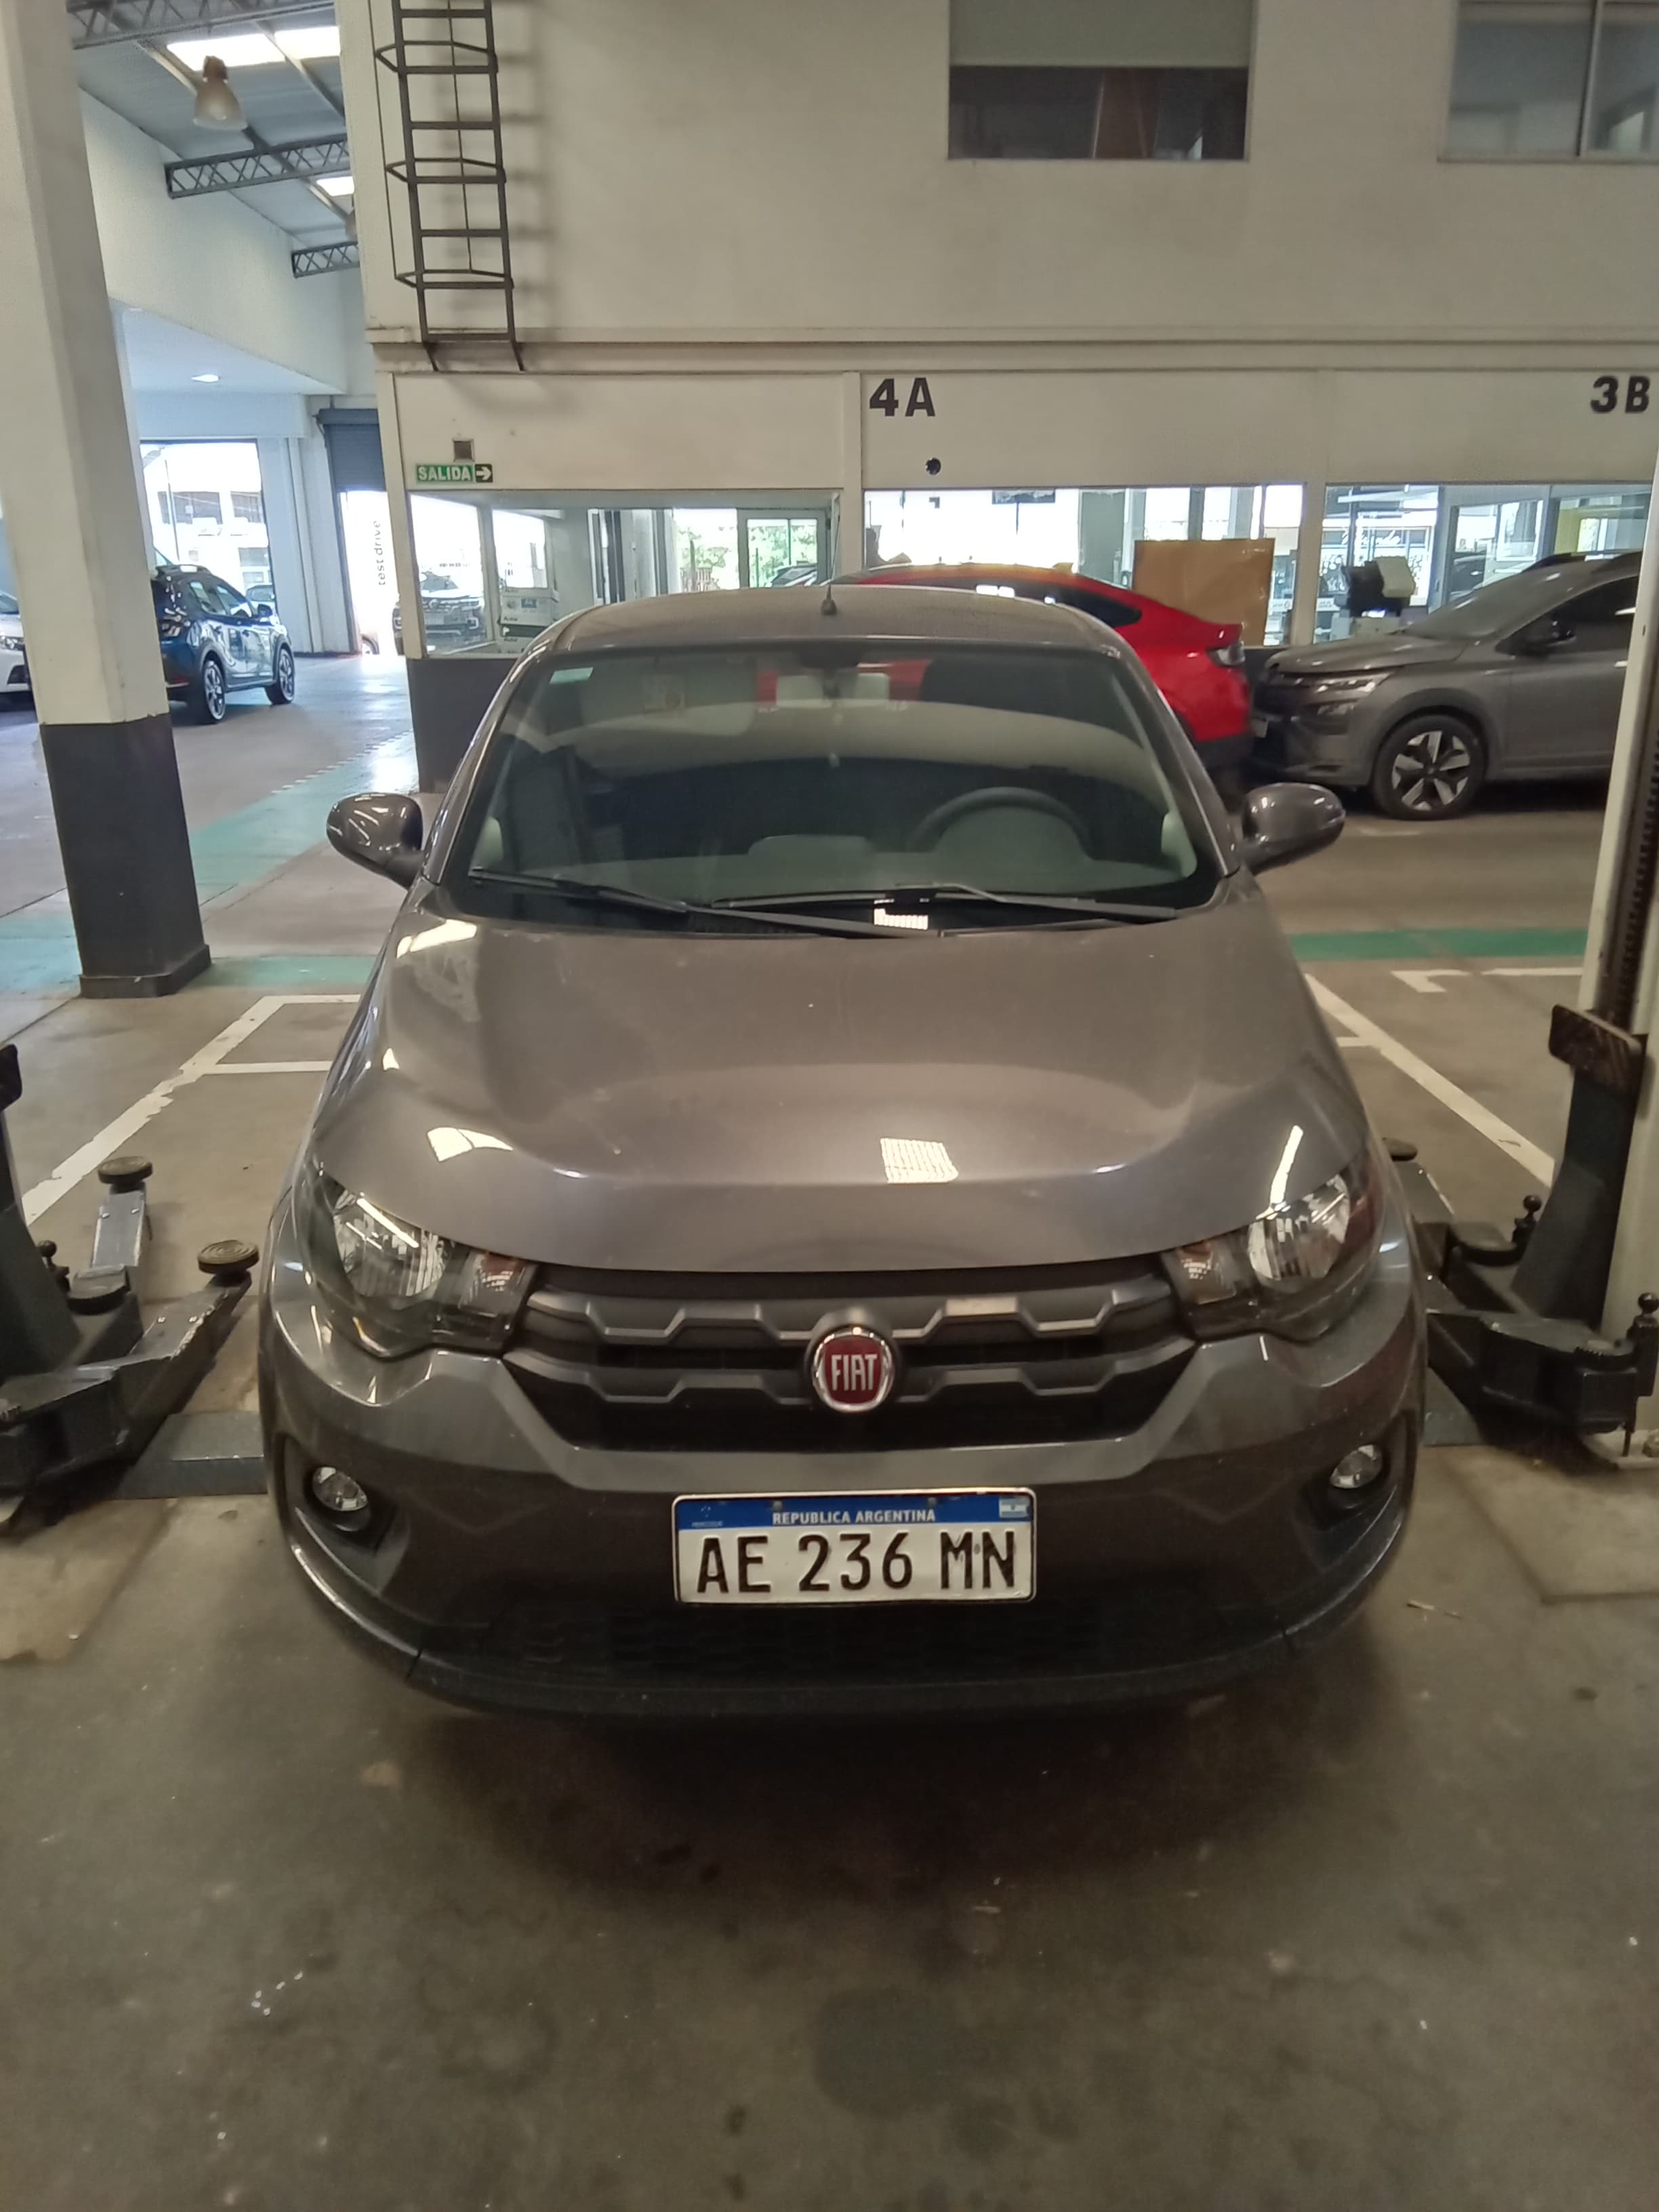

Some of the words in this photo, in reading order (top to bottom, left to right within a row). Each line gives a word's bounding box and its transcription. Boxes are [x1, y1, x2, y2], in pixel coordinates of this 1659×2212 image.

[868, 377, 937, 418] 4A
[1590, 374, 1651, 415] 3B
[417, 466, 472, 481] SALIDA
[373, 520, 384, 556] drive
[375, 559, 386, 586] test
[831, 1354, 878, 1391] FIAT
[772, 1511, 851, 1525] REPUBLICA
[855, 1509, 936, 1524] ARGENTINA
[697, 1535, 772, 1594] AE
[798, 1532, 914, 1593] 236
[939, 1530, 1016, 1590] MN
